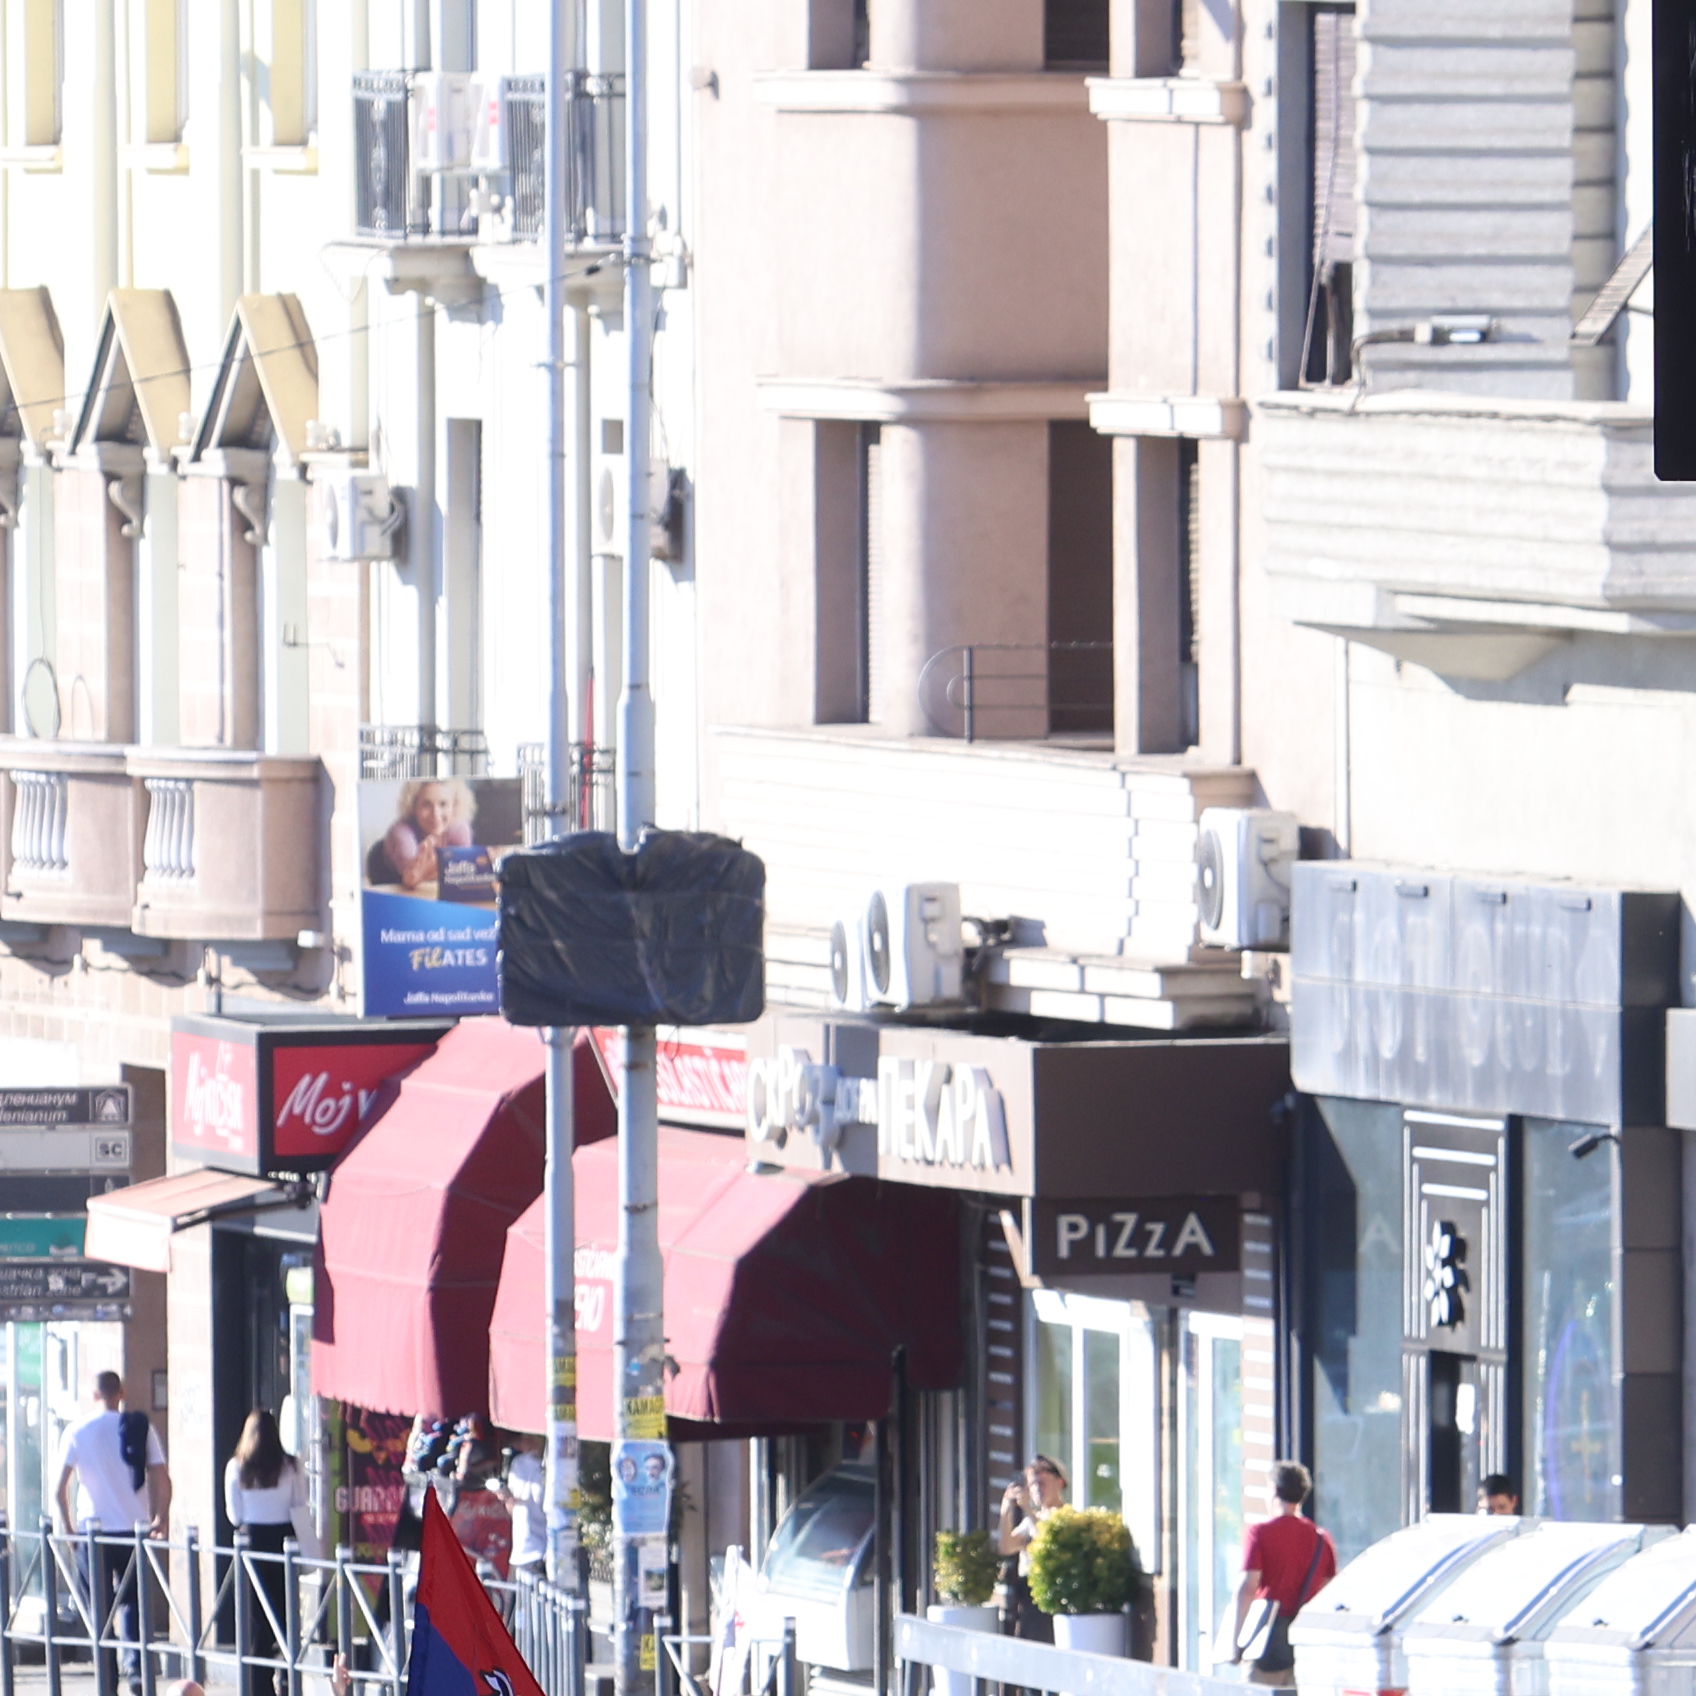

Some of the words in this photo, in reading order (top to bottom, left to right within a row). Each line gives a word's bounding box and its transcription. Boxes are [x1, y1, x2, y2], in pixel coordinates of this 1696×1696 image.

[380, 928, 425, 944] Mama
[427, 926, 444, 943] od
[447, 925, 472, 942] sad
[404, 991, 430, 1005] Jaffa
